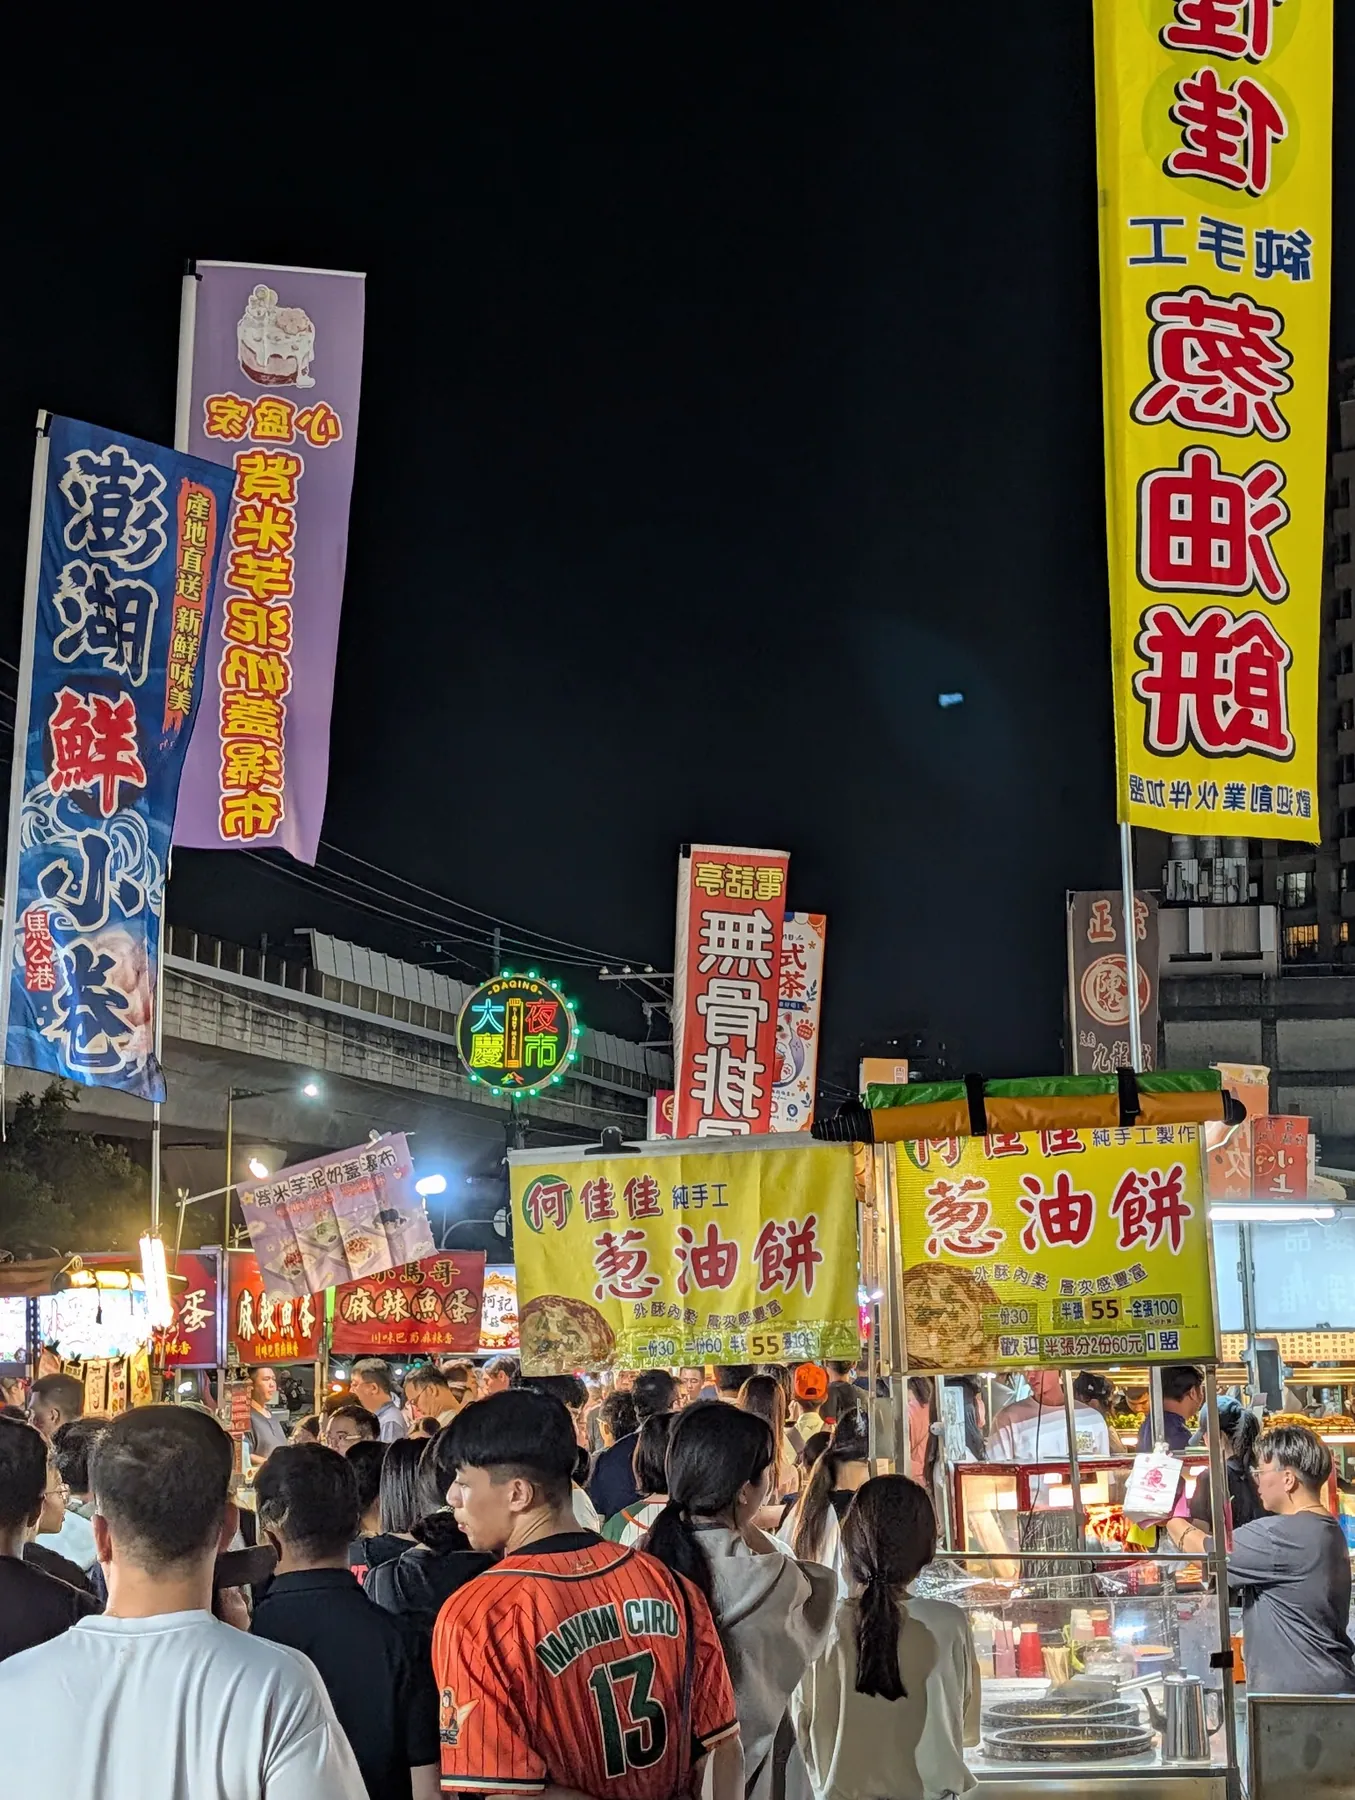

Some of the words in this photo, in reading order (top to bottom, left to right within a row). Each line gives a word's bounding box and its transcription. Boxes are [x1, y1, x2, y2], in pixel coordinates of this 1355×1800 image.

[168, 606, 202, 715] 新鮮味美
[24, 912, 55, 991] 馬公港
[525, 998, 559, 1068] 夜市
[1092, 1125, 1197, 1147] 純手工製作
[526, 1174, 663, 1230] 何佳佳
[672, 1183, 729, 1209] 純手工
[179, 1289, 216, 1334] 蛋
[344, 1287, 477, 1325] 麻辣魚蛋
[1090, 1299, 1119, 1319] 55
[752, 1335, 780, 1356] 55
[1045, 1333, 1144, 1357] 半張分2份60元
[535, 1604, 621, 1677] MAYAW
[623, 1598, 679, 1638] CIRU
[588, 1648, 668, 1779] 13
